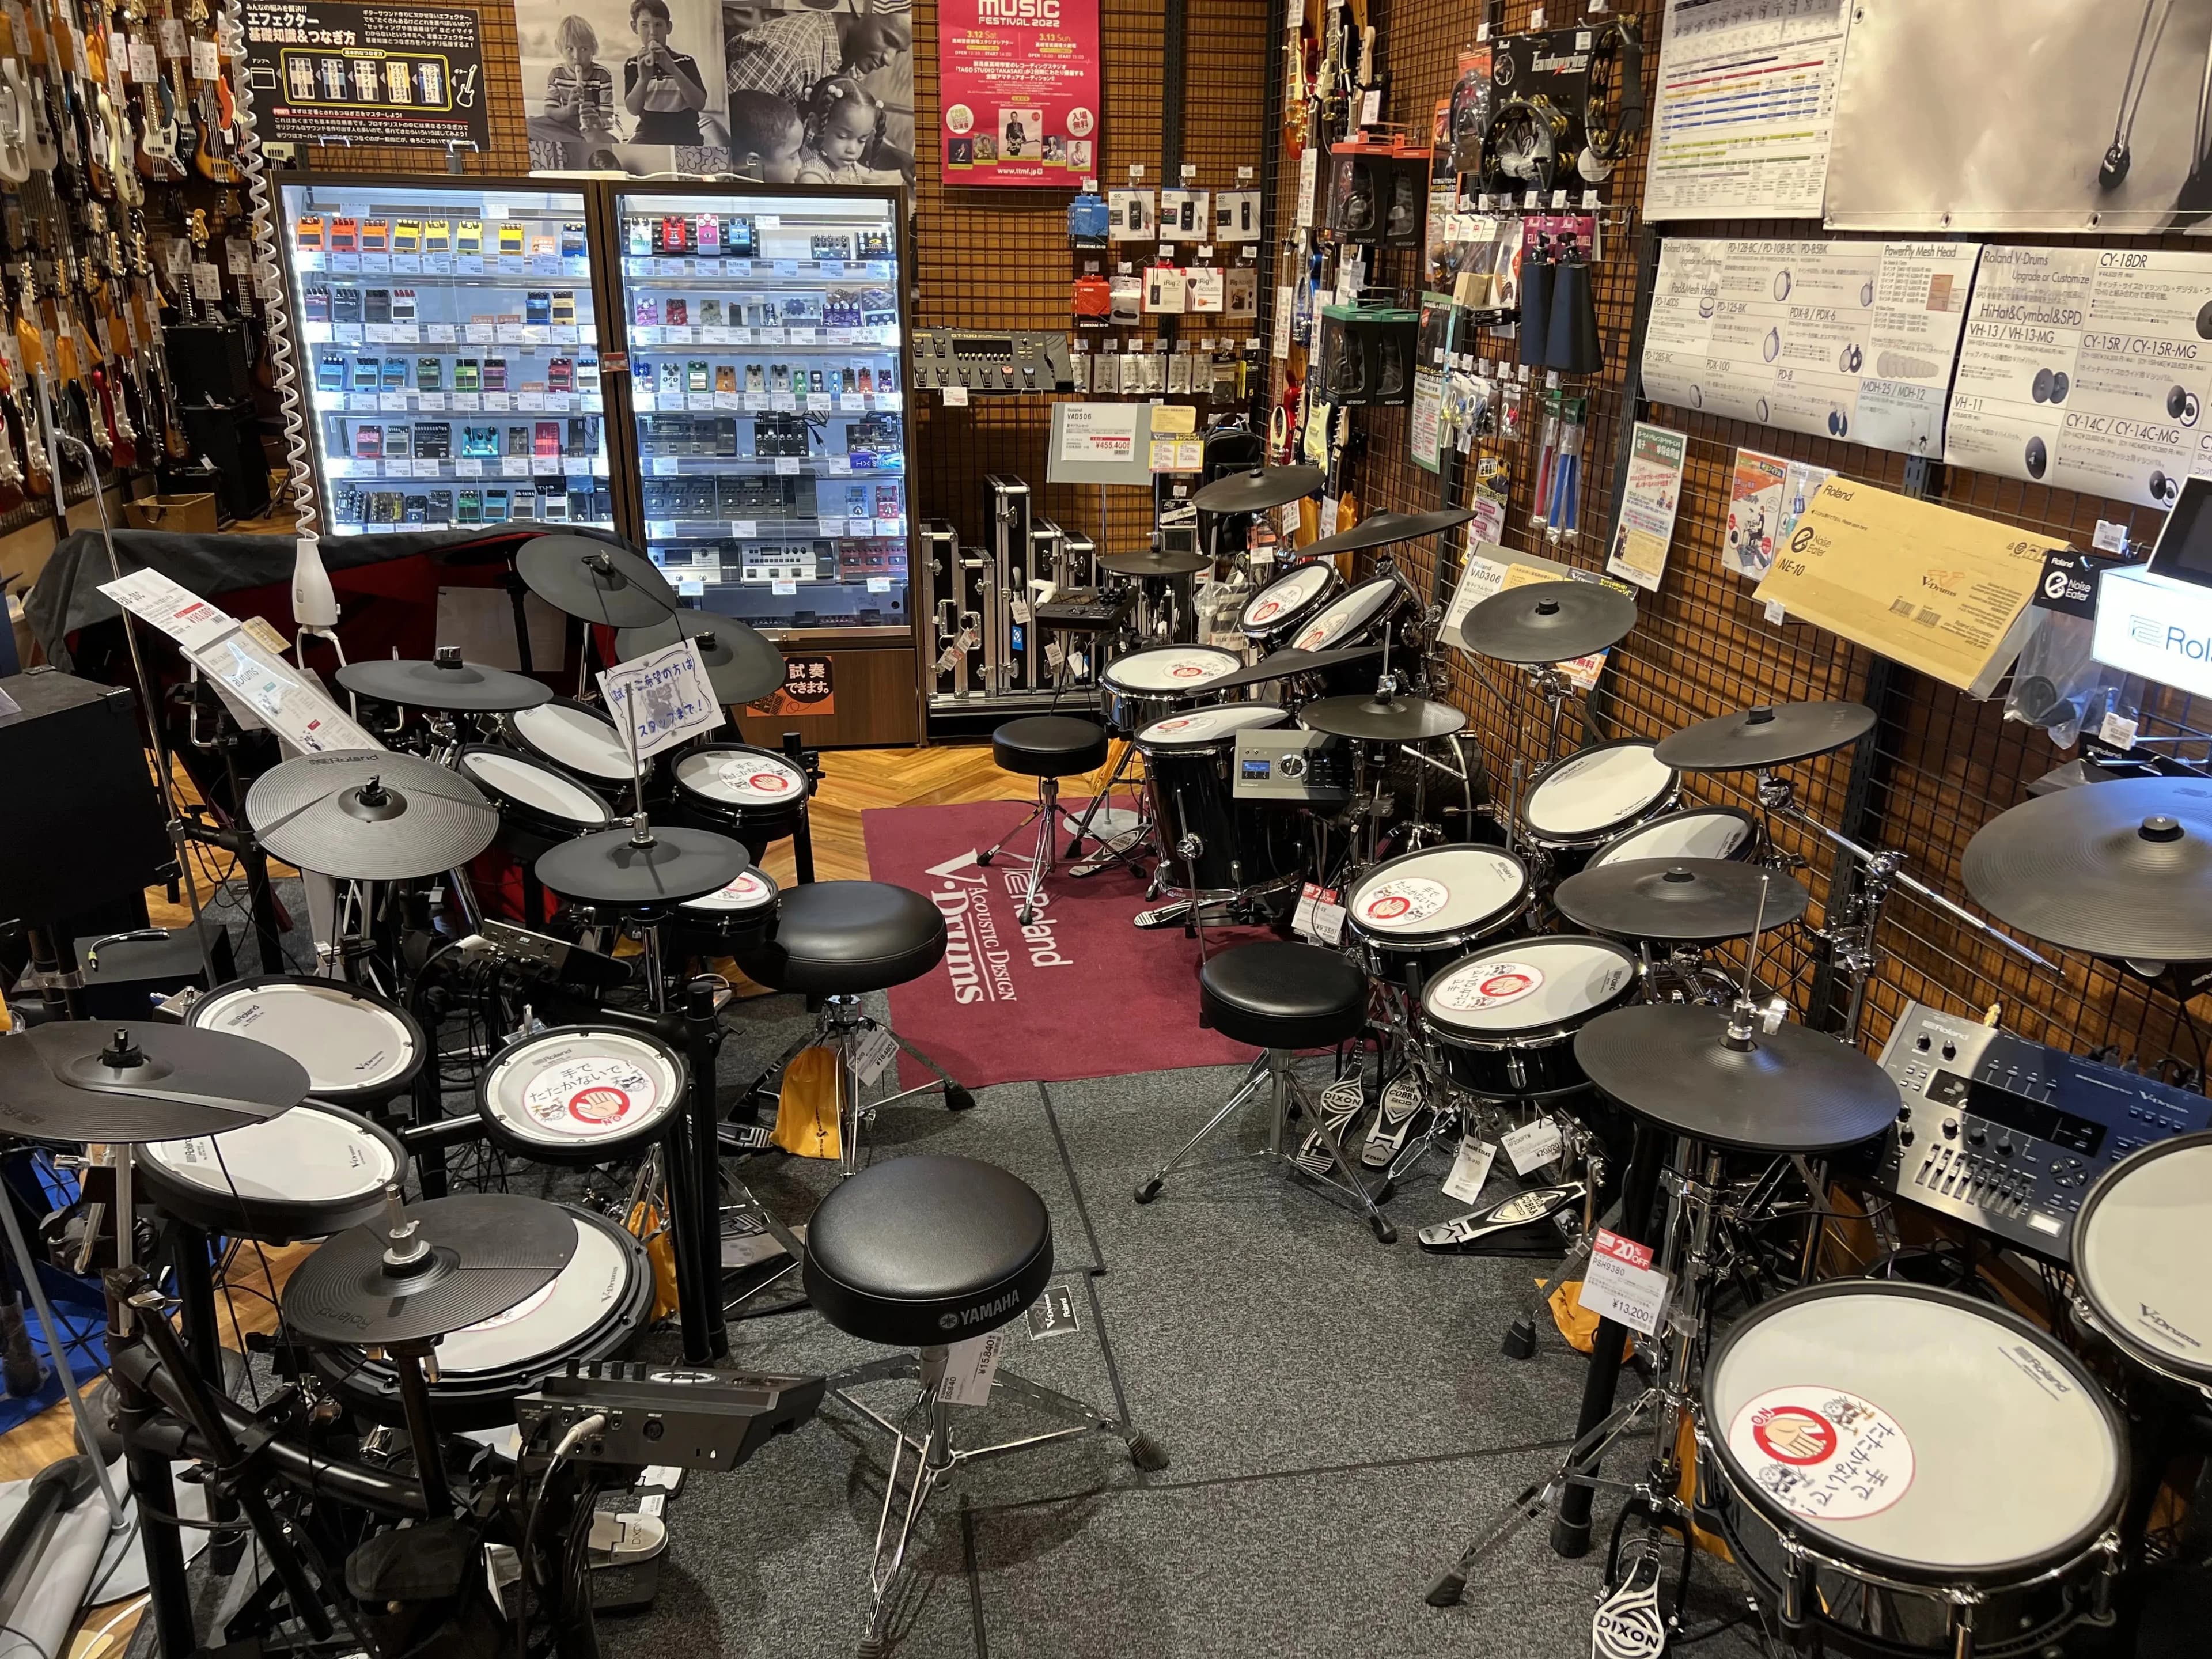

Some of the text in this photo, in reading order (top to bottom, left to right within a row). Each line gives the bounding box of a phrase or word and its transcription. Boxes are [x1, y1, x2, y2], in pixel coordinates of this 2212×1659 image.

[248, 13, 320, 28] エフェクター
[979, 17, 1060, 28] FESTIVAL 2022
[248, 27, 357, 46] 基礎知識&つなぎ方
[967, 30, 983, 38] 3.12
[1039, 33, 1055, 41] 3.13
[1936, 245, 1957, 257] Head
[1983, 249, 2048, 266] Roland V-Drums
[2100, 252, 2149, 269] CY-18DR
[2012, 270, 2090, 285] Upgrade or Customize
[1980, 303, 2082, 325] HiHat&Cymbal&SPD
[1969, 323, 1999, 338] VH-13
[2008, 325, 2055, 344] VH-13-MG
[2083, 334, 2121, 351] CY-15R
[2132, 339, 2198, 359] CY-15R-MG
[2066, 414, 2104, 431] CY-14C
[2115, 421, 2180, 444] CY-14C-MG
[1823, 484, 1855, 502] Roland
[1806, 544, 1827, 557] Eater
[1813, 535, 1832, 548] Noise
[1473, 560, 1492, 571] Roland
[1778, 558, 1806, 577] NE-10
[2051, 557, 2074, 569] Roland
[1470, 569, 1502, 584] VAD306
[2067, 578, 2092, 592] Noise
[1922, 575, 1957, 597] V-Drums
[2065, 589, 2089, 602] Eater
[2166, 626, 2212, 663] Rol
[788, 662, 825, 679] 試奏
[785, 680, 830, 694] できます。
[329, 754, 380, 764] Roland
[925, 847, 987, 1005] V-Drums
[968, 887, 1017, 1002] ACOUSTIC DESIGN
[236, 1004, 260, 1021] Roland
[1934, 1024, 1970, 1041] Roland
[354, 1051, 384, 1071] V-Drums
[543, 1047, 573, 1063] Roland
[560, 1062, 595, 1080] 手で
[1389, 1088, 1419, 1101] COBRA
[1396, 1083, 1416, 1093] IRON
[1324, 1092, 1362, 1107] DIXON
[2139, 1089, 2190, 1114] V-Drums
[1520, 1195, 1540, 1217] COBRA
[1592, 1256, 1626, 1277] PSH9380
[1631, 1254, 1649, 1268] OFF
[601, 1266, 619, 1304] V-Drums
[960, 1289, 1021, 1326] YAMAHA
[1044, 1294, 1056, 1330] V-Drums
[1059, 1297, 1071, 1318] Roland
[1612, 1298, 1650, 1322] ¥13,200
[2139, 1301, 2202, 1349] V-Drums
[978, 1339, 995, 1375] ¥15,840
[2029, 1358, 2071, 1394] Roland
[1850, 1467, 1889, 1501] 手で
[631, 1518, 643, 1546] DIXON
[1597, 1614, 1660, 1649] DIXON
